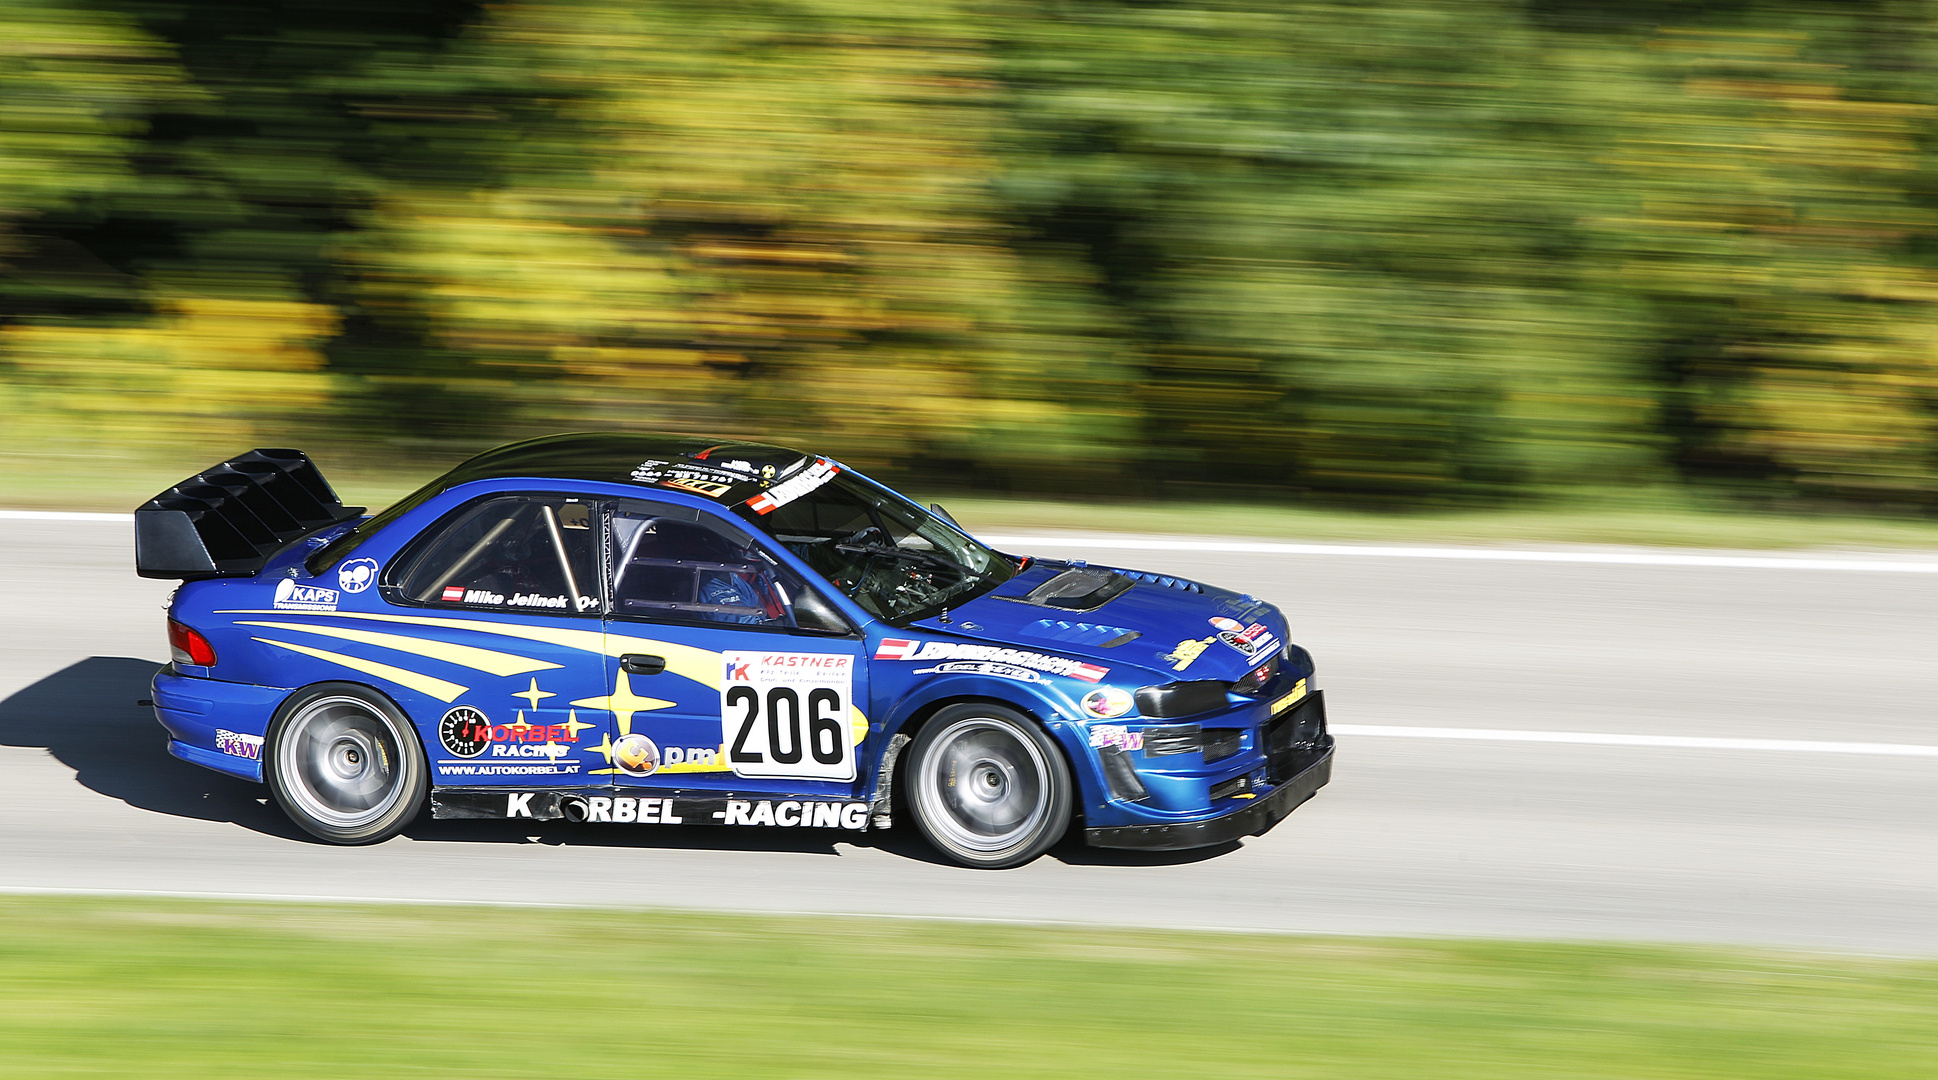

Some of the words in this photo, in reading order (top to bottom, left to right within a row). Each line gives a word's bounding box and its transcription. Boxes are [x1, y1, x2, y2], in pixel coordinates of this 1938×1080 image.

[292, 587, 334, 602] KAPS
[463, 589, 504, 605] Mike
[507, 592, 568, 609] Jelinek
[273, 602, 337, 611] TRANSMISSIONS
[760, 655, 848, 668] KASTNER
[726, 685, 844, 765] 206
[473, 725, 580, 742] KORBEL
[224, 739, 259, 758] KW
[491, 744, 570, 757] RACING
[438, 765, 581, 776] WWW.AUTOKORBEL.AT
